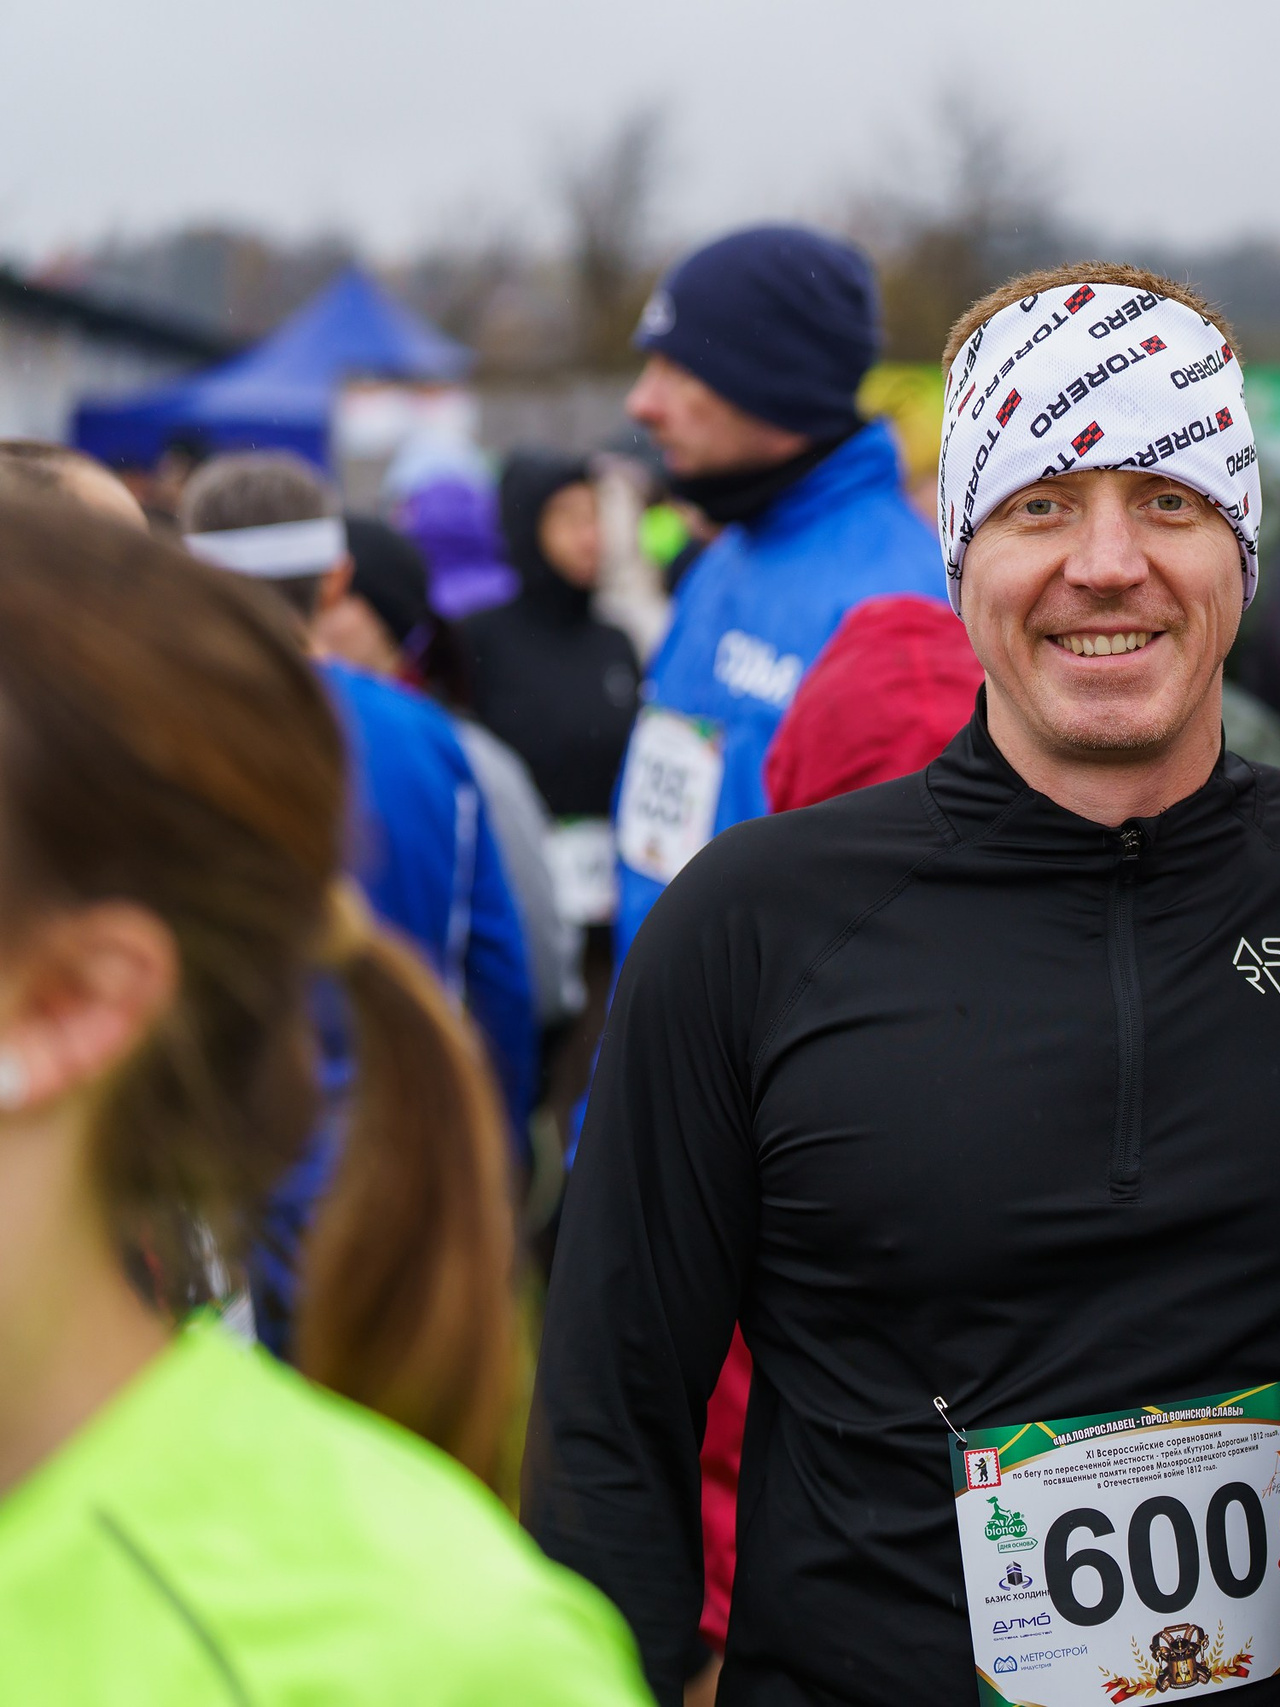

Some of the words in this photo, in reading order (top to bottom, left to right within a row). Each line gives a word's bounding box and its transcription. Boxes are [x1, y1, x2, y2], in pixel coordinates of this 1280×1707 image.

[971, 312, 1069, 420] TORERO
[1170, 350, 1225, 390] TORERO
[1030, 347, 1147, 438] TORERO
[1226, 444, 1257, 477] RERO
[1053, 1418, 1136, 1446] «МАЛОЯРОСЛАВЕЦ
[1141, 1412, 1169, 1427] ГОРОД
[1169, 1408, 1211, 1421] ВОИНСКОЙ
[1212, 1406, 1244, 1417] СЛАВЫ»
[1097, 1440, 1164, 1458] Всероссийские
[1166, 1431, 1222, 1447] соревнования
[1024, 1469, 1041, 1480] бегу
[1043, 1468, 1053, 1476] по
[1055, 1459, 1112, 1476] пересеченной
[1113, 1454, 1154, 1467] местности
[1161, 1449, 1182, 1460] трейл
[1217, 1437, 1248, 1449] Дорогами
[1250, 1431, 1263, 1441] 1812
[1043, 1473, 1097, 1486] посвященные
[1099, 1469, 1127, 1479] памяти
[1128, 1464, 1154, 1475] героев
[1156, 1451, 1226, 1469] Малоярославецкого
[1228, 1445, 1258, 1457] сражения
[1103, 1472, 1162, 1488] Отечественной
[1163, 1469, 1184, 1478] войне
[1186, 1464, 1202, 1474] 1812
[986, 1524, 1027, 1537] bionova
[1044, 1481, 1268, 1627] 600
[985, 1594, 1011, 1604] БАЗИС
[1020, 1644, 1088, 1663] МЕТРОСТРОЙ
